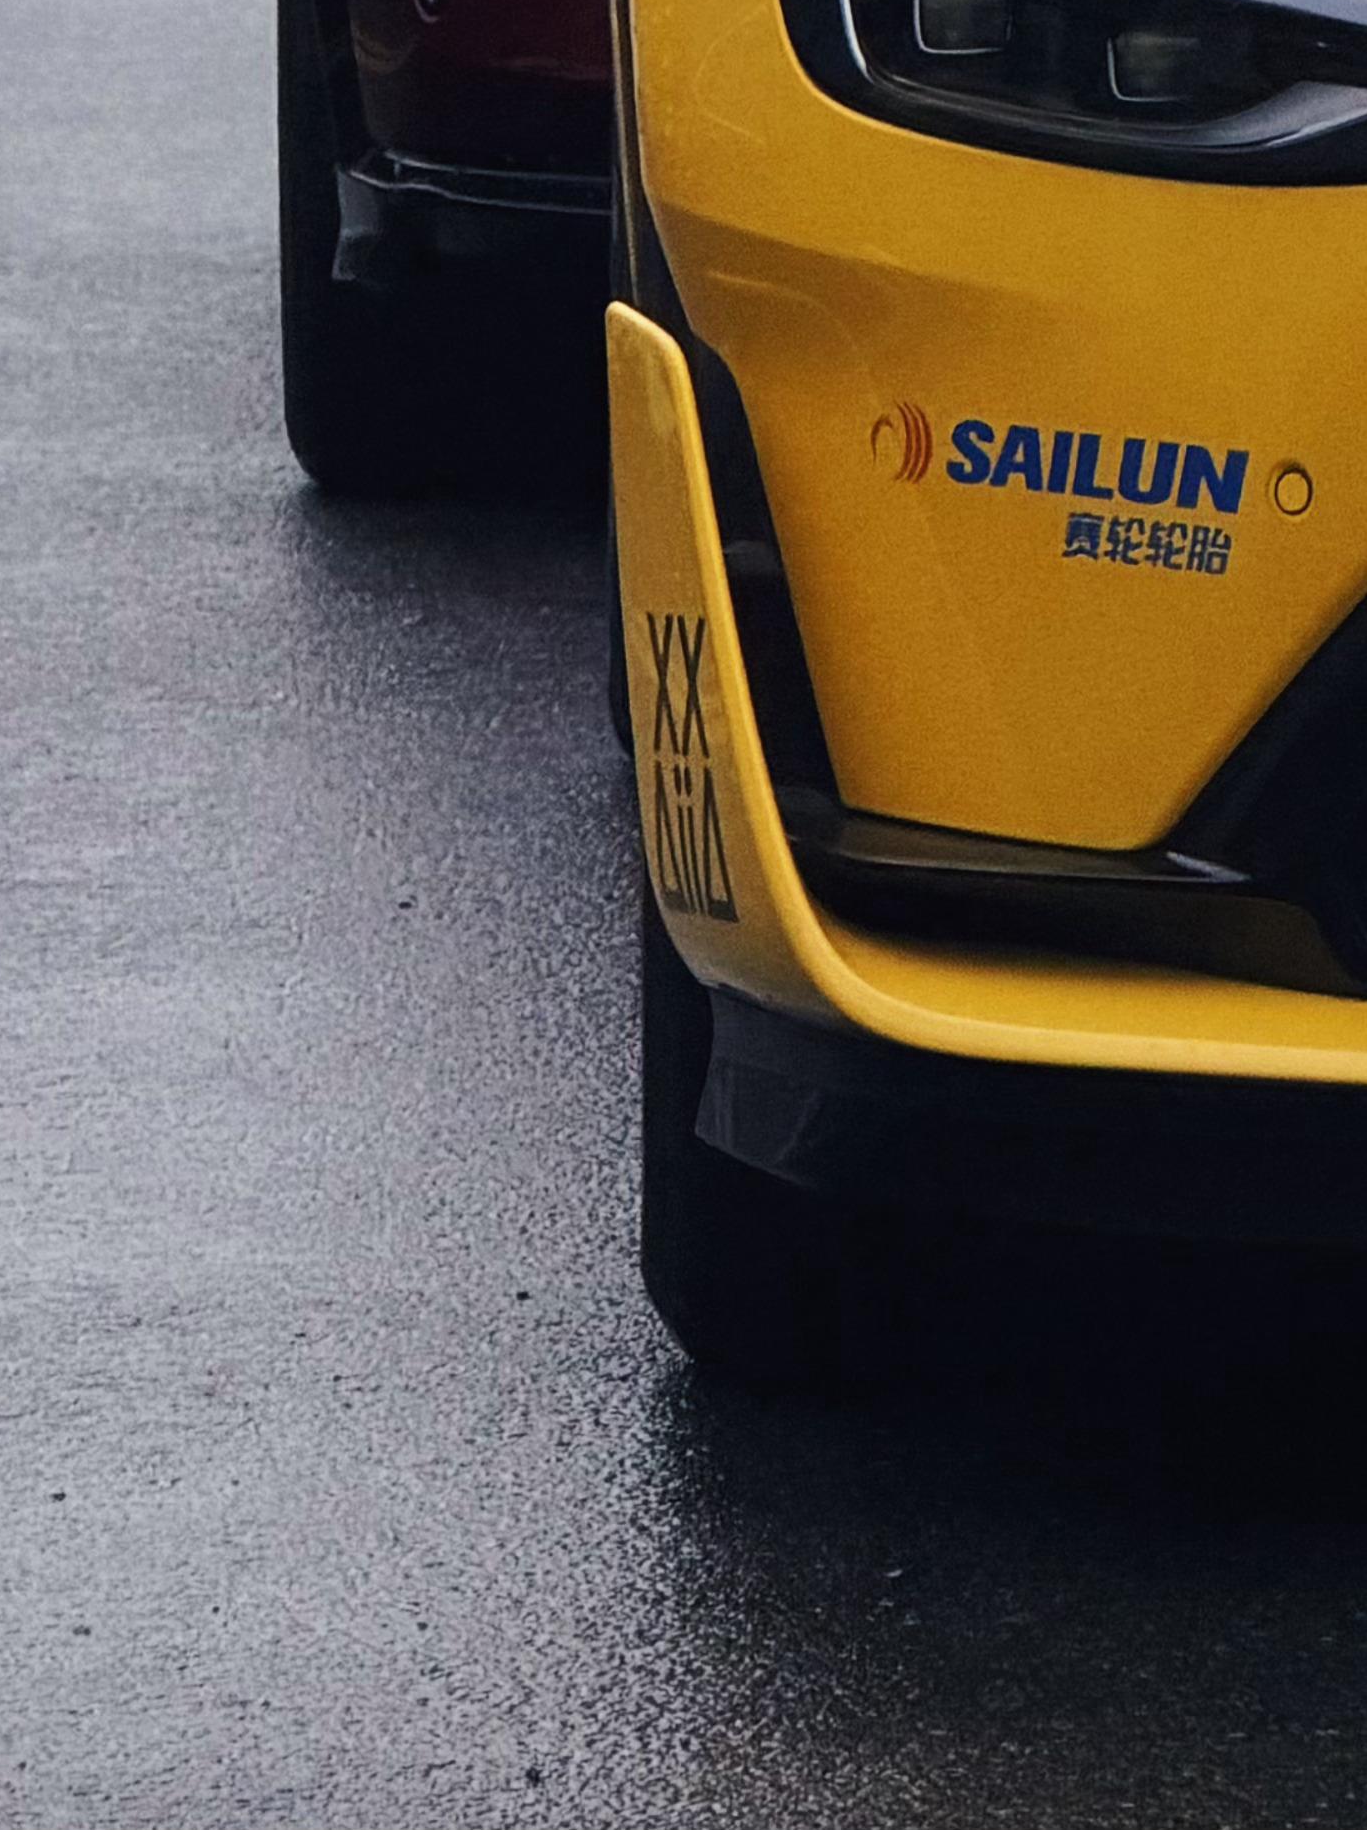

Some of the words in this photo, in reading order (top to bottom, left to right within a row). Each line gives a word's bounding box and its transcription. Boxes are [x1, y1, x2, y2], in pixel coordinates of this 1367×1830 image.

[946, 419, 1249, 514] SAILUN
[1062, 511, 1232, 575] 赛轮轮胎
